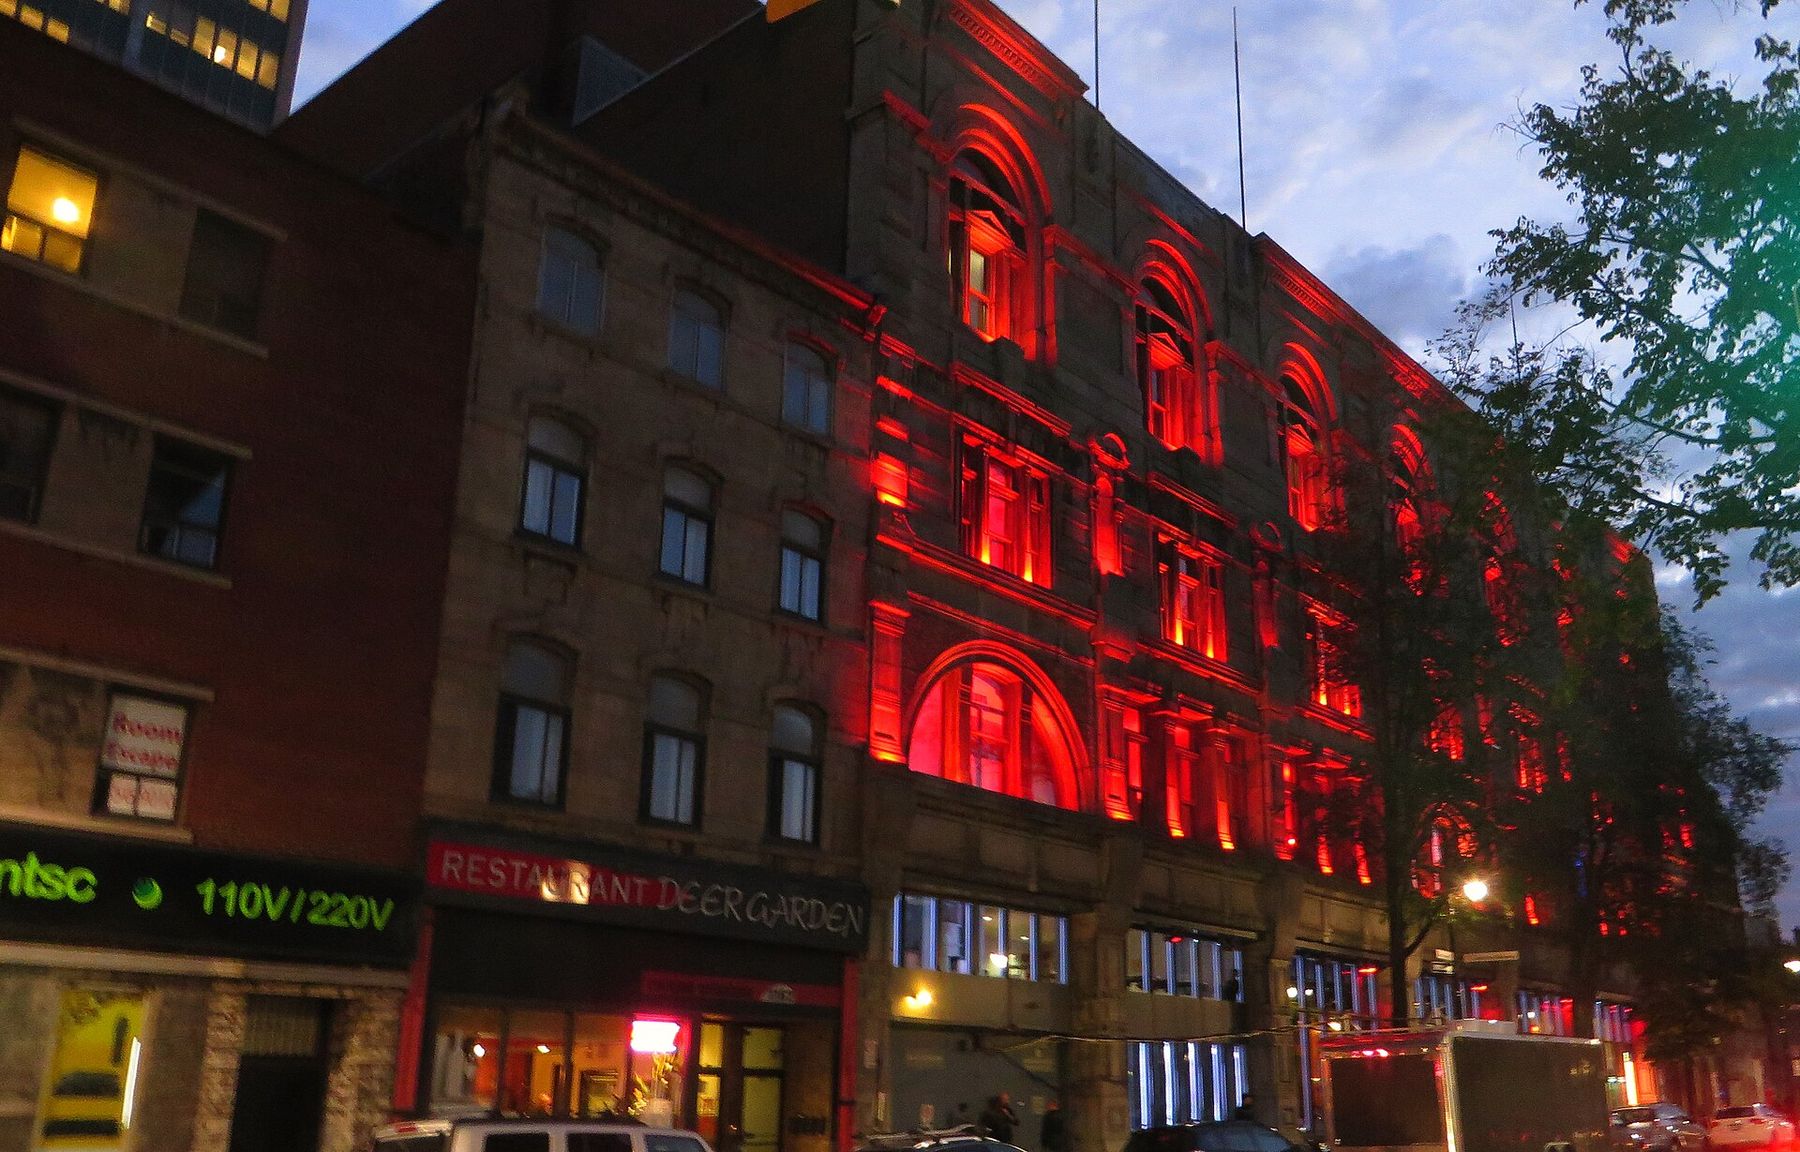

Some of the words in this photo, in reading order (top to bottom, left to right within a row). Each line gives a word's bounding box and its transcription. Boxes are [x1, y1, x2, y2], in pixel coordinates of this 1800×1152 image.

[196, 877, 395, 931] 110V/220V
[441, 849, 649, 906] RESTAURANT
[656, 876, 743, 922] DEER
[745, 891, 864, 937] GARDEN
